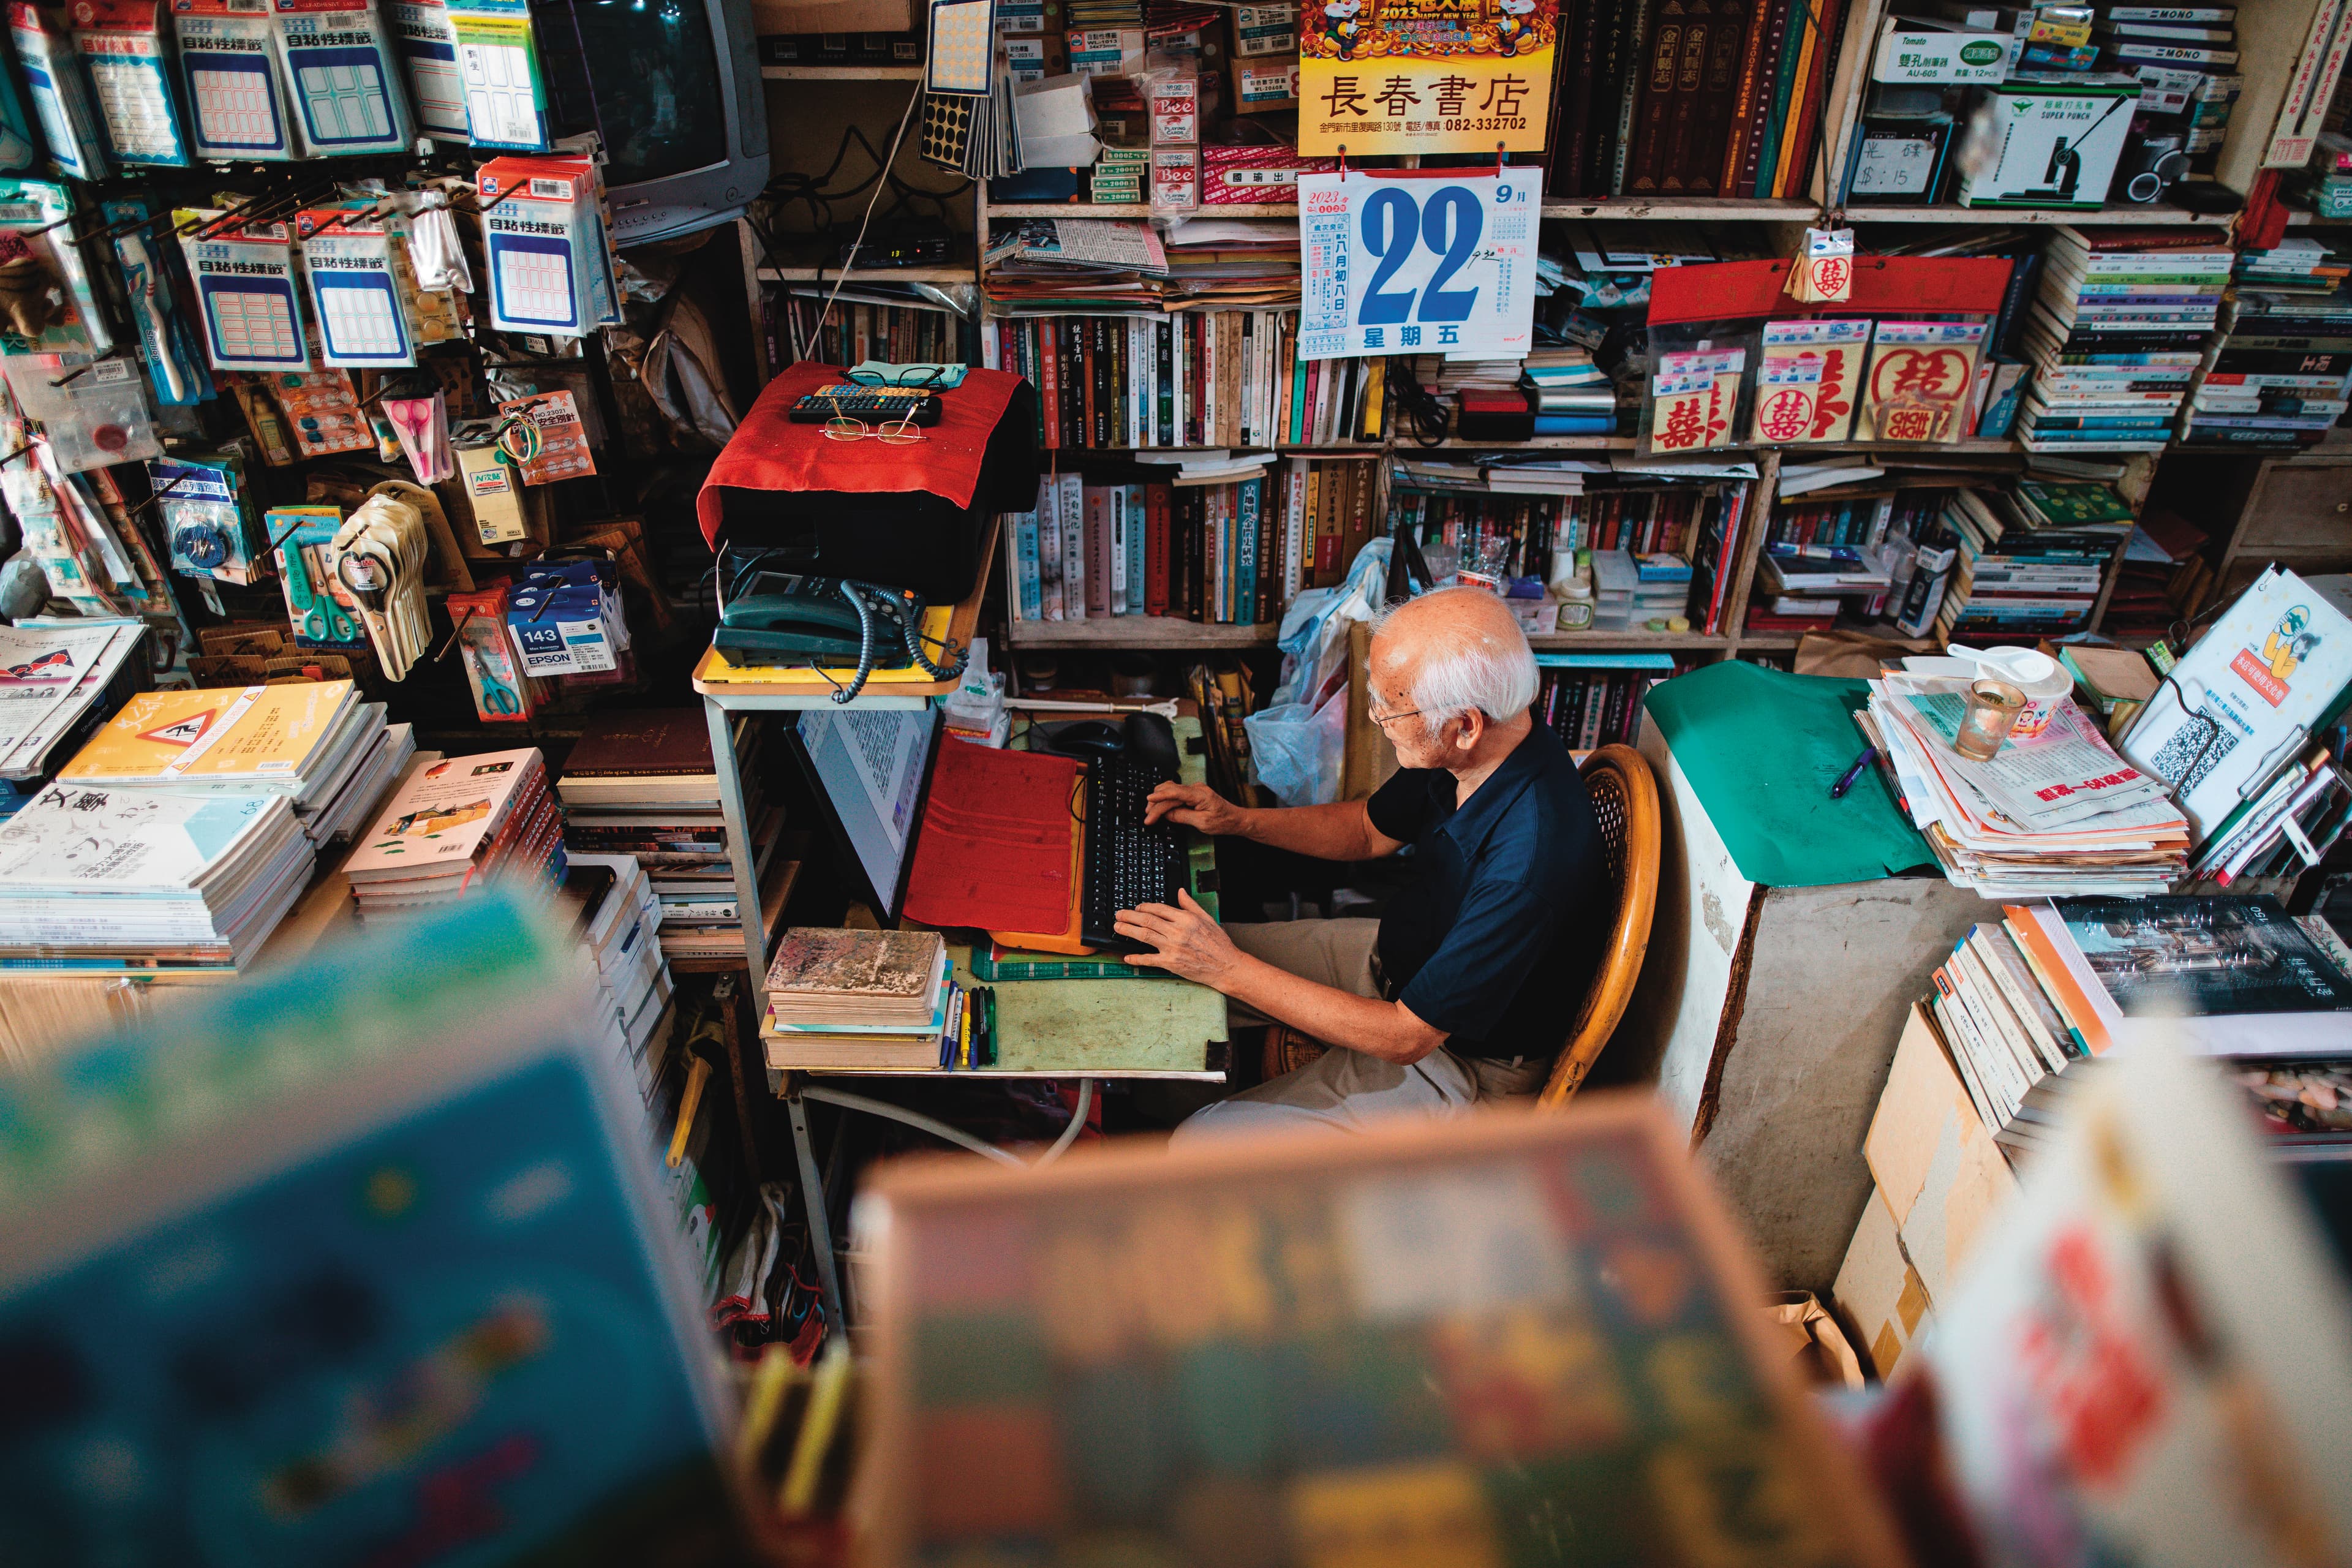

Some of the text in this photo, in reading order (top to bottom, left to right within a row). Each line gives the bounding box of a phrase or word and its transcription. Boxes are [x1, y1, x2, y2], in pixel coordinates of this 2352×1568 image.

[1380, 7, 1419, 21] 2023
[2158, 10, 2195, 20] MONO
[1902, 37, 1926, 45] Tomato
[2165, 48, 2201, 60] MONO
[1321, 74, 1530, 118] 長春書店
[2067, 112, 2091, 121] PUNCH
[1446, 117, 1526, 131] 082-332702
[1309, 190, 1340, 204] 2023
[1358, 186, 1483, 325] 22
[1334, 240, 1348, 311] 八月初八日
[526, 337, 544, 346] CR1616
[1363, 326, 1459, 349] 星期五
[535, 409, 566, 418] NO.23021
[524, 629, 557, 643] 143
[527, 654, 570, 665] EPSON
[2236, 655, 2285, 701] 本店可使用文化幣
[2250, 907, 2269, 922] 150
